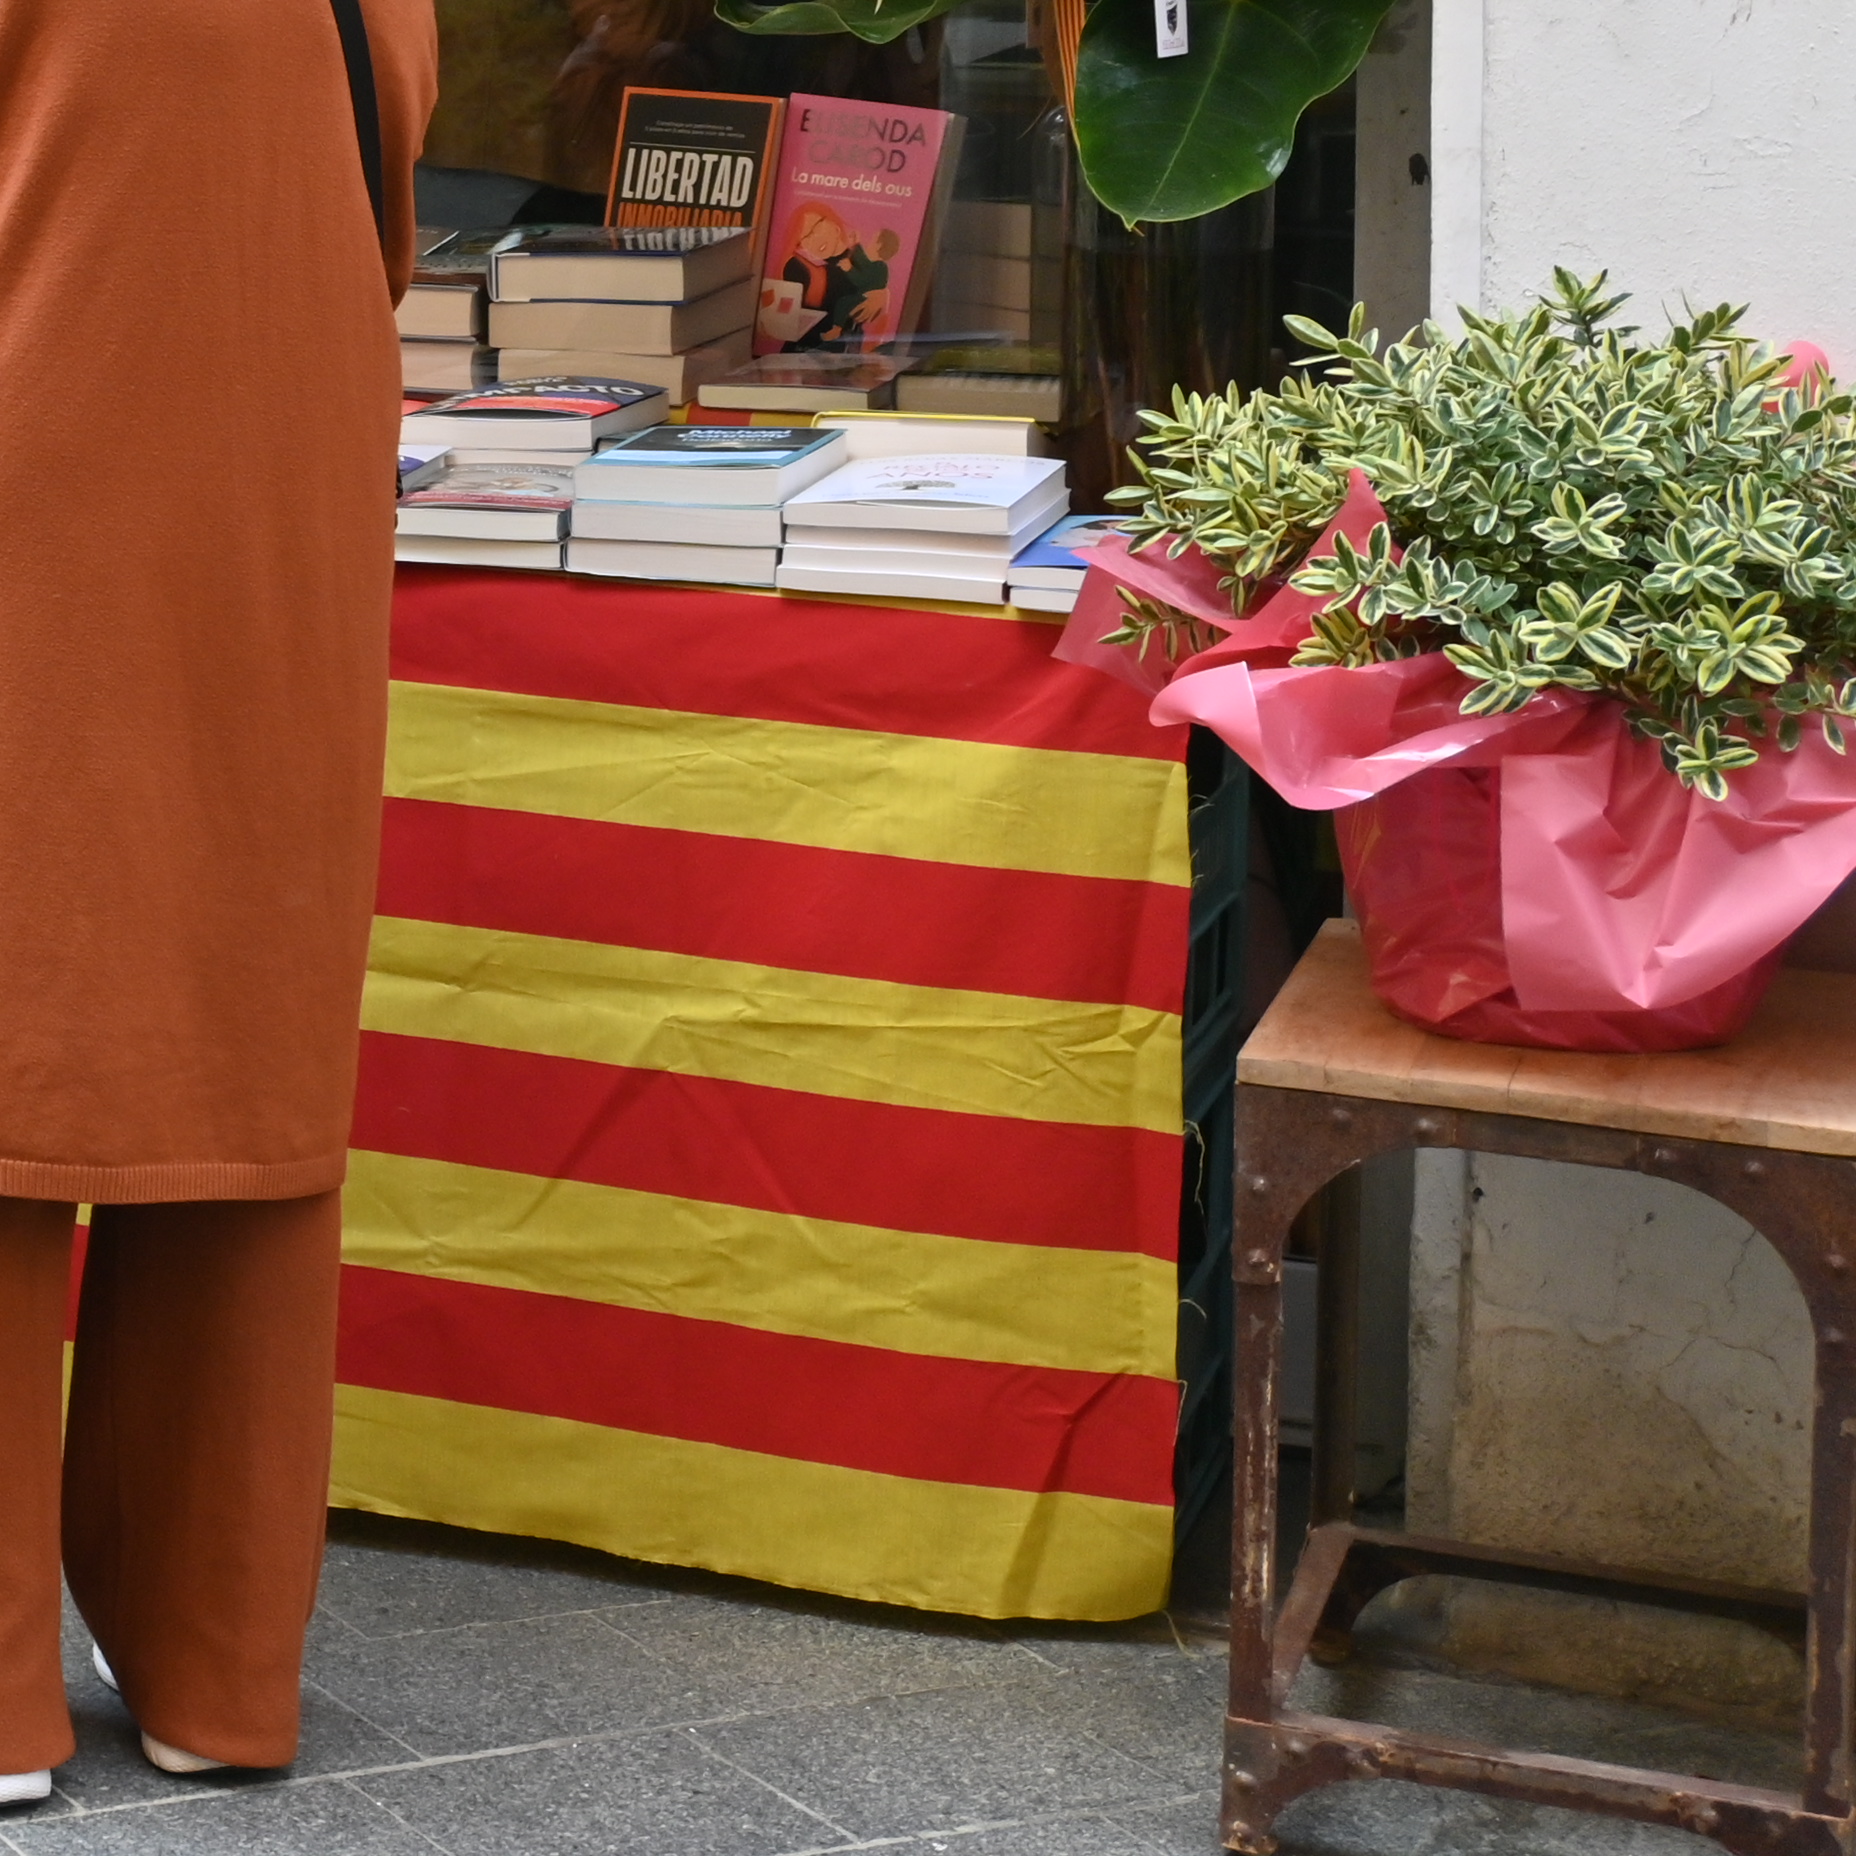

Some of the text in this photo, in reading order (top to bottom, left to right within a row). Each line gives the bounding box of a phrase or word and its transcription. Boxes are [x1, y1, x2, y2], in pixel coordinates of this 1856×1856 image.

[800, 108, 926, 146] ELISENDA
[808, 139, 906, 173] CAROD
[621, 147, 754, 208] LIBERTAD
[791, 166, 912, 198] La mare dels ous
